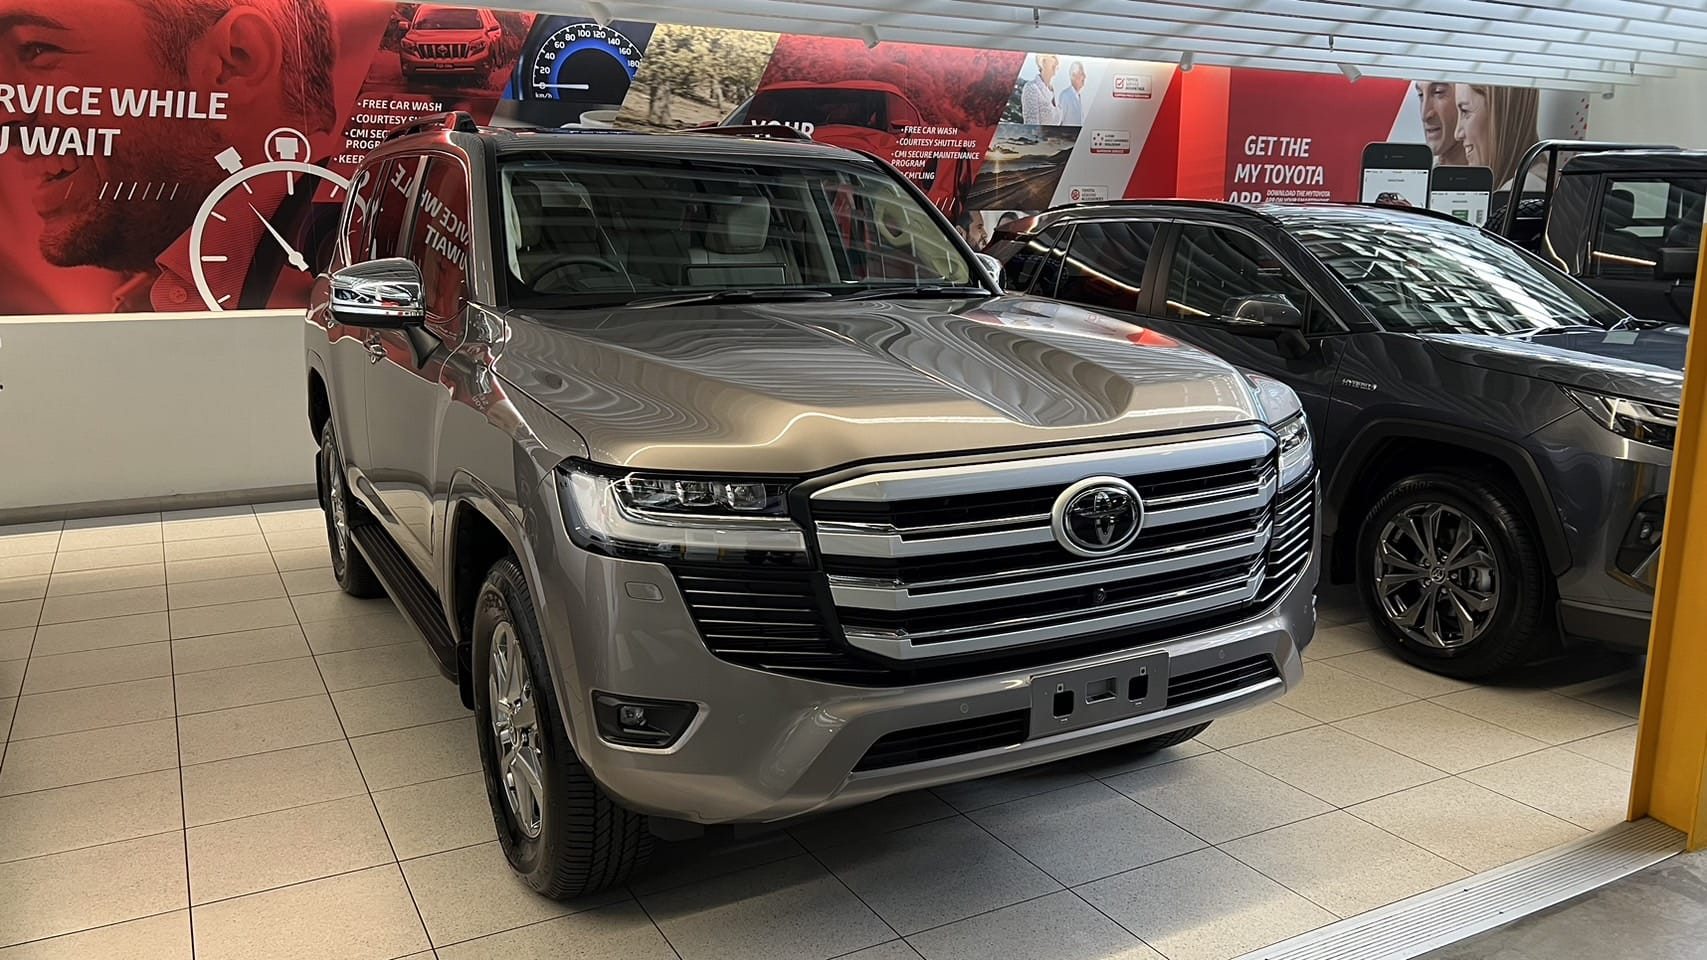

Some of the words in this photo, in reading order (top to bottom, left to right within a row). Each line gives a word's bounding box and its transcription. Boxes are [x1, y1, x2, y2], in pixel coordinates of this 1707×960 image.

[565, 33, 576, 41] 80
[577, 29, 591, 38] 100
[592, 30, 606, 39] 120
[554, 41, 565, 49] 60
[607, 37, 621, 46] 140
[619, 47, 632, 55] 160
[544, 52, 556, 60] 40
[627, 60, 640, 68] 180
[540, 66, 551, 74] 20
[110, 88, 229, 120] WHILE
[362, 99, 388, 109] FREE
[389, 100, 410, 110] CAR
[411, 101, 443, 112] WASH
[356, 114, 407, 125] COURTESY
[349, 128, 369, 138] CMI
[904, 125, 922, 134] FREE
[922, 126, 936, 135] CAR
[937, 127, 958, 136] WASH
[19, 126, 121, 157] WAIT
[345, 140, 381, 150] PROGR
[899, 138, 933, 147] COURTESY
[933, 139, 963, 148] SHUTTLE
[963, 140, 977, 148] BUS
[1244, 135, 1278, 156] GET
[1280, 136, 1312, 157] THE
[894, 150, 907, 158] CMI
[907, 150, 933, 159] SECURE
[932, 151, 980, 160] MAINTENANCE
[891, 159, 926, 168] PROGRAM
[1234, 163, 1262, 183] MY
[1264, 164, 1324, 185] TOYOTA
[1266, 189, 1296, 197] DOWNLOAD
[1297, 189, 1306, 197] THE
